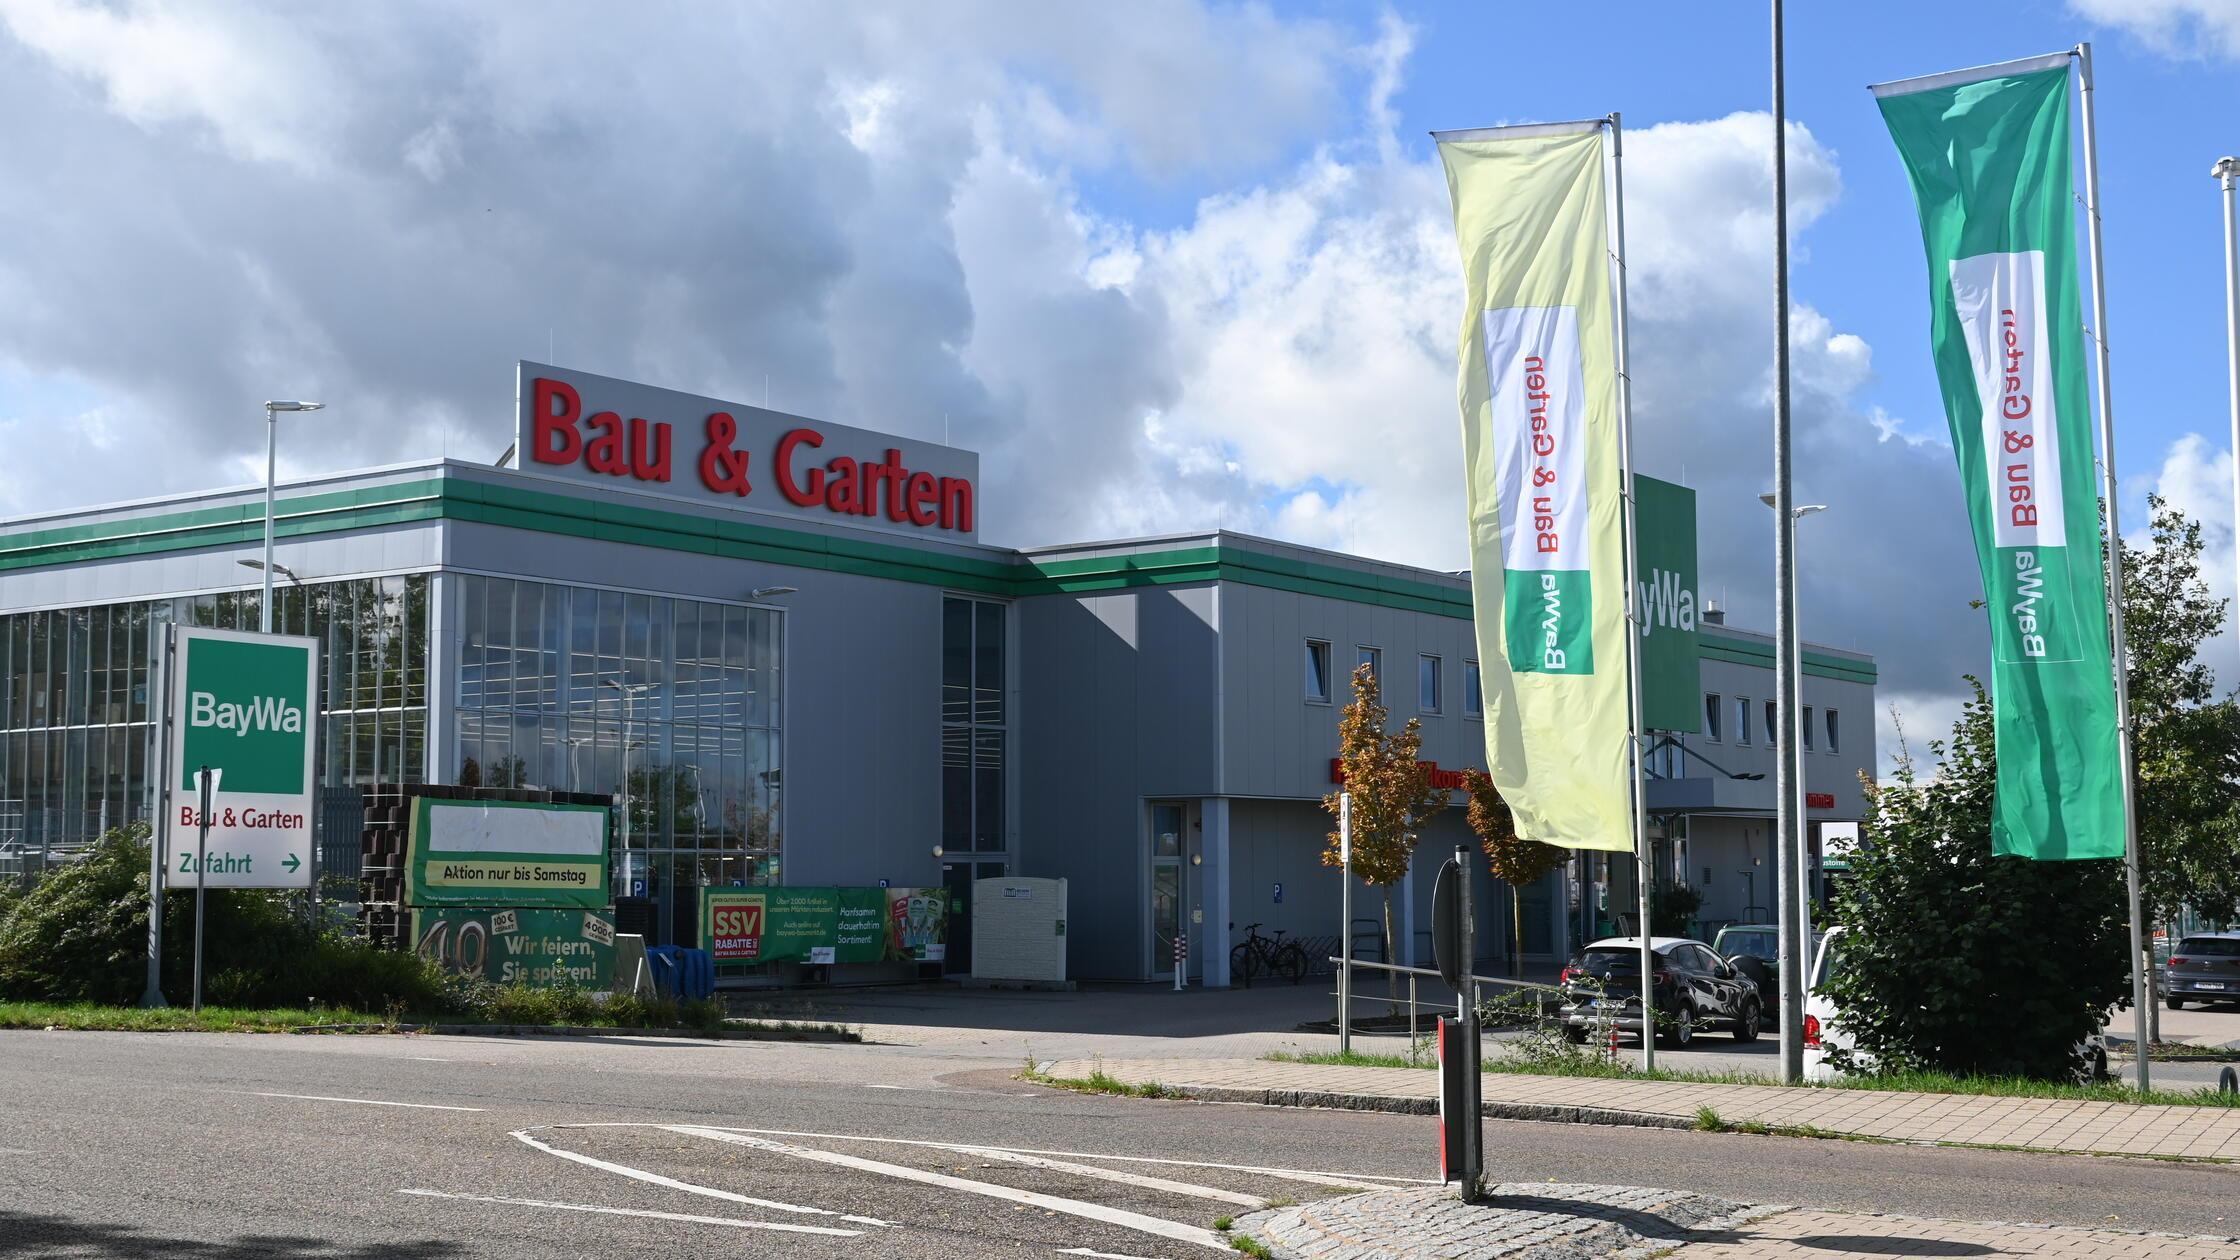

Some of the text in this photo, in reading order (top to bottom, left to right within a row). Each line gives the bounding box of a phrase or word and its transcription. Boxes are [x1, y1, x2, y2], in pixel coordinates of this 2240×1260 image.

[532, 377, 973, 532] Bau & Garten
[1625, 567, 1695, 637] yWa
[191, 691, 302, 737] BayWa
[181, 806, 303, 829] Bau & Garten
[179, 852, 252, 873] Zufahrt
[444, 865, 586, 885] Aktion nur bis Samstag
[634, 881, 642, 896] P
[1274, 885, 1280, 896] P
[493, 915, 506, 926] 100
[715, 911, 758, 936] SSV
[504, 935, 595, 958] Wir feiern,
[715, 938, 752, 949] RABATTE
[502, 961, 529, 980] Sie
